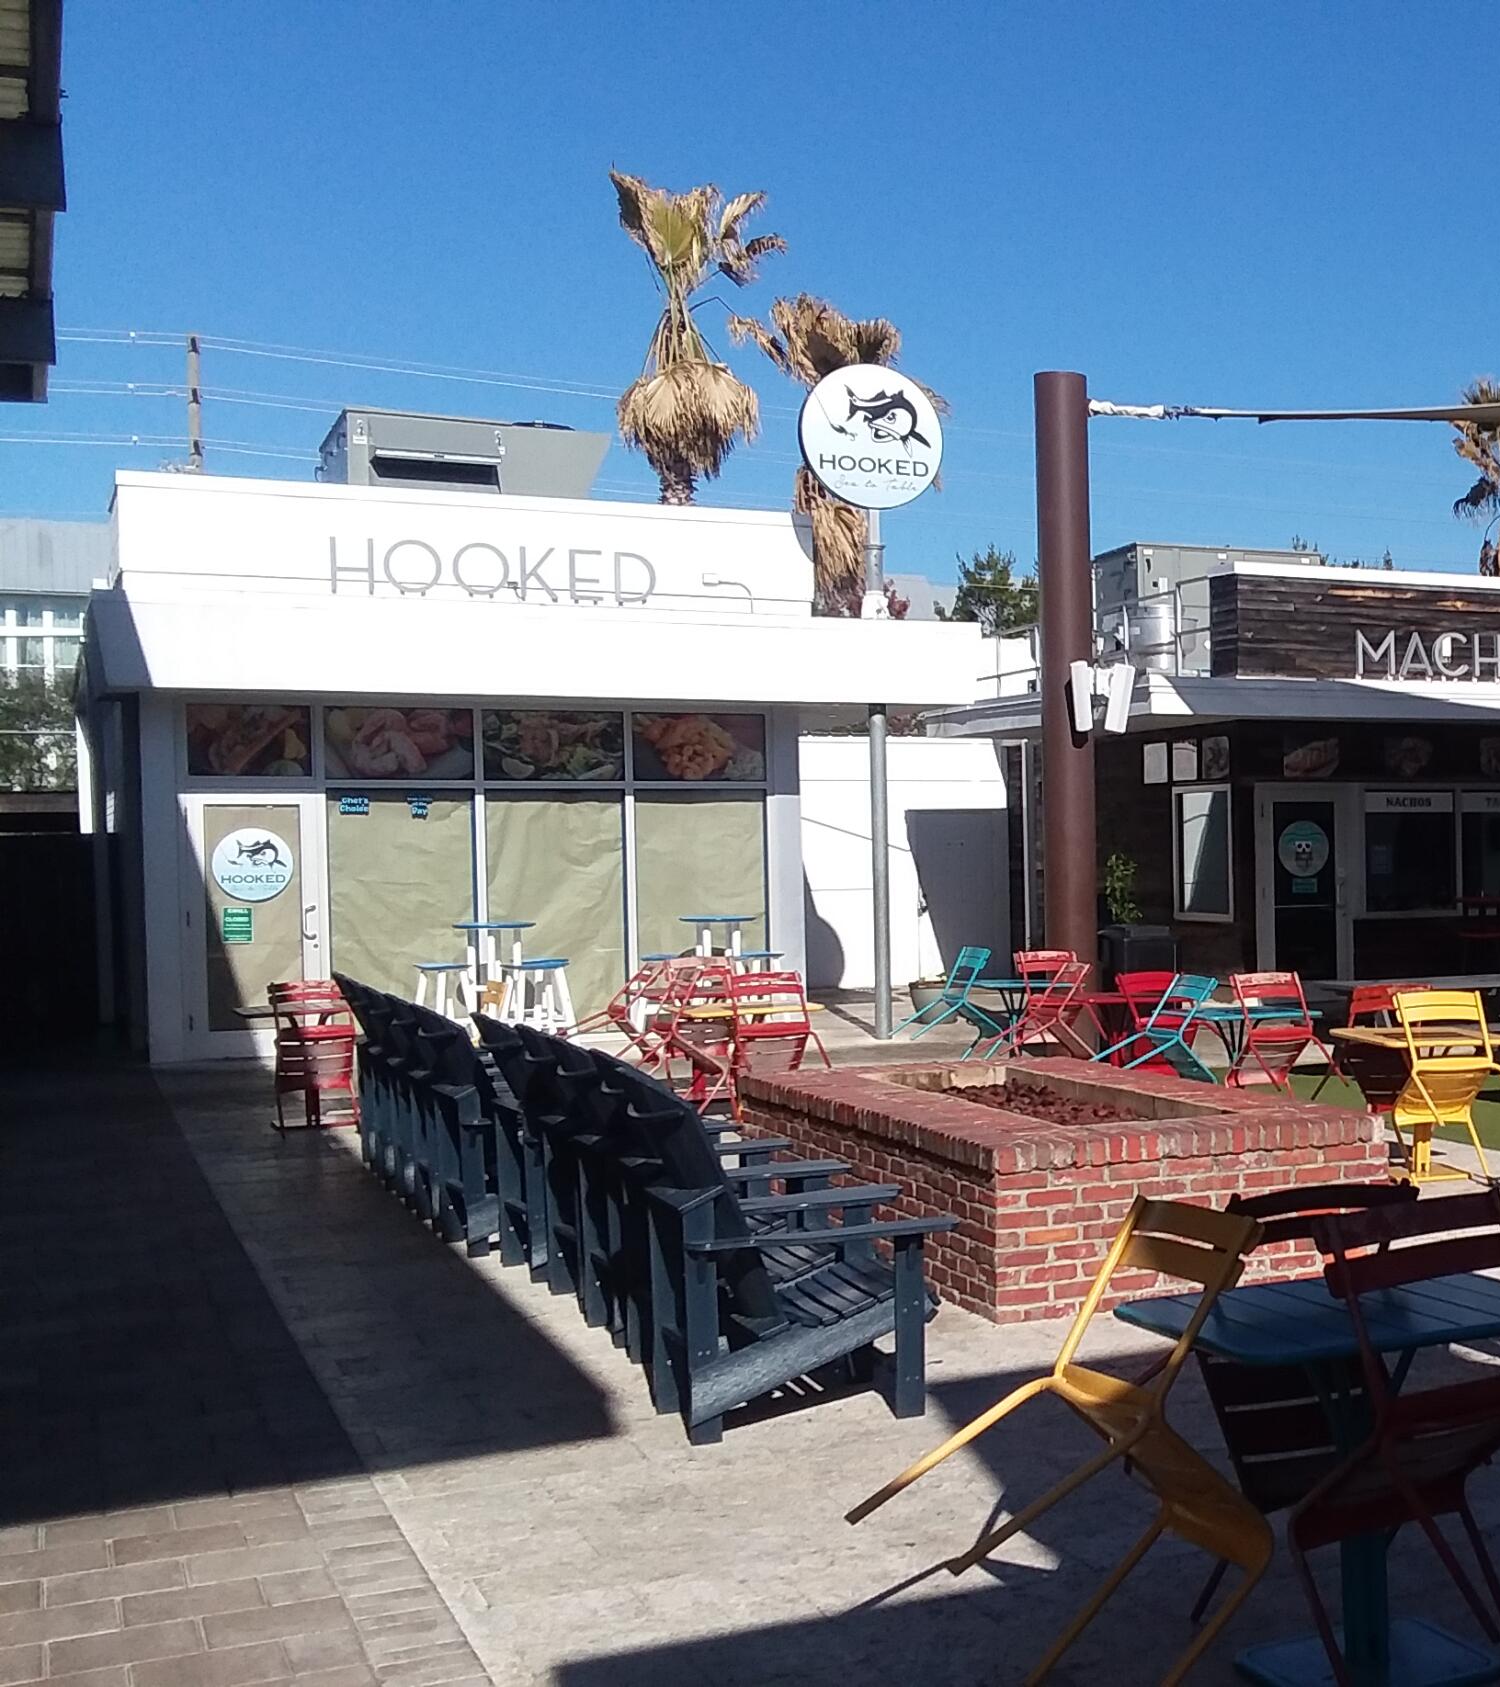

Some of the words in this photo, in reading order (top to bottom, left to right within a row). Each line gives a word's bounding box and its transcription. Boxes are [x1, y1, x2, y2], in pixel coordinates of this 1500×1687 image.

[819, 453, 929, 477] HOOKED
[329, 536, 657, 604] HOOKED
[1386, 797, 1432, 808] NACHOS
[221, 874, 286, 884] HOOKED
